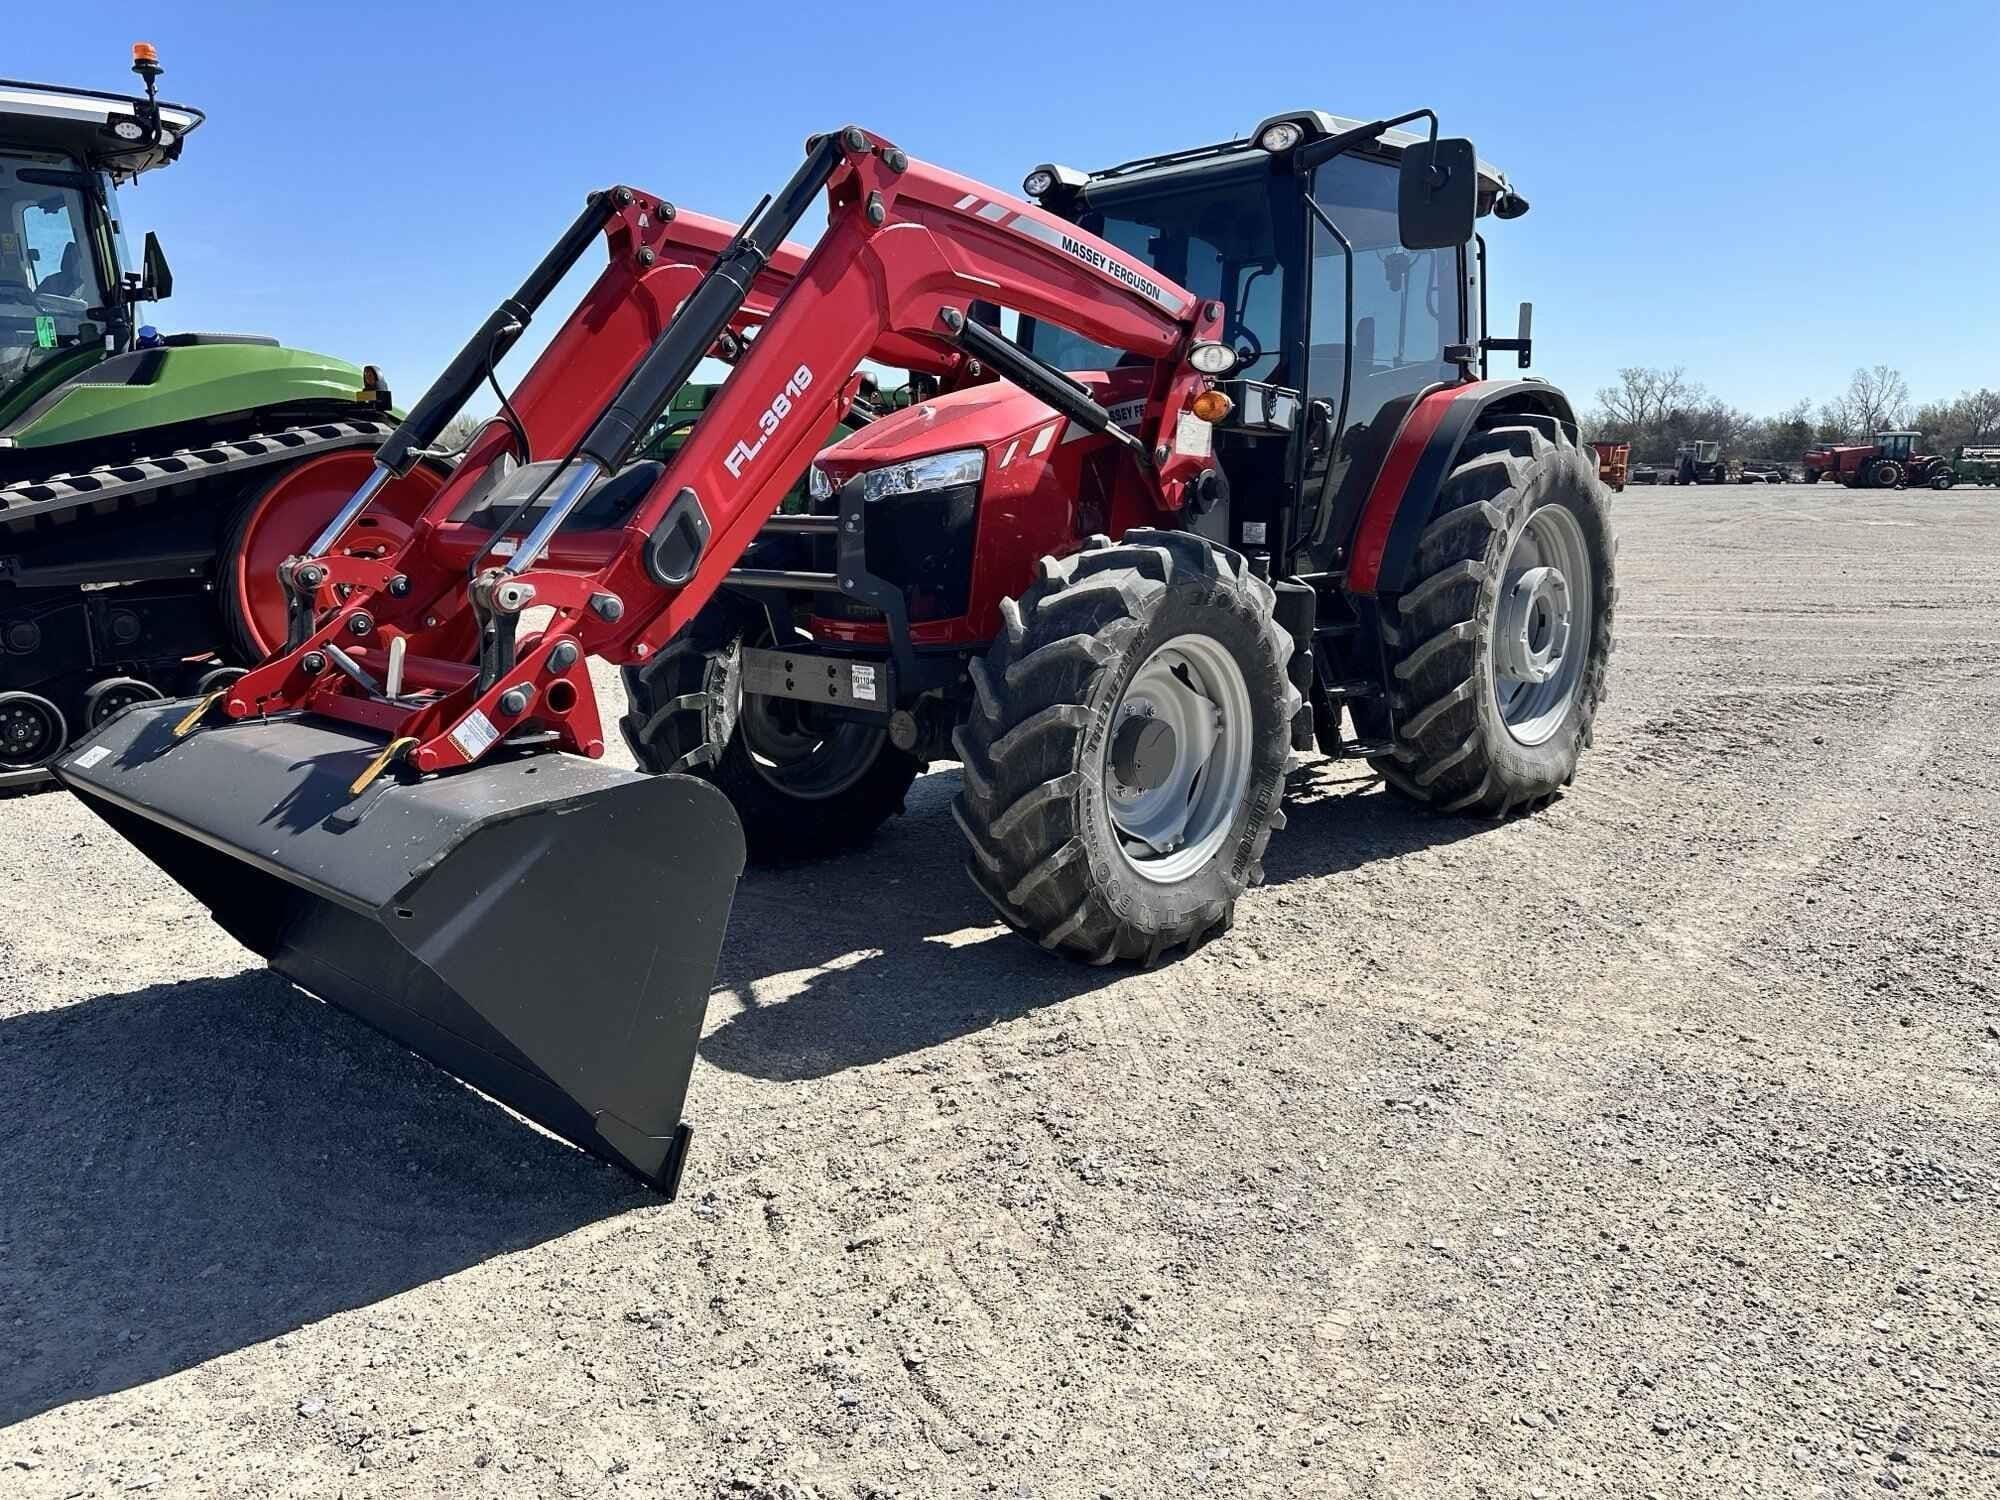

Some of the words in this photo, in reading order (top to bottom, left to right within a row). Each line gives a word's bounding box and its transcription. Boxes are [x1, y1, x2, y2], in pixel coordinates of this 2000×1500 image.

[1061, 235, 1106, 269] MASSEY
[1108, 261, 1161, 301] FERGUSON
[723, 364, 813, 480] FL.3819
[1109, 405, 1132, 422] SSEY
